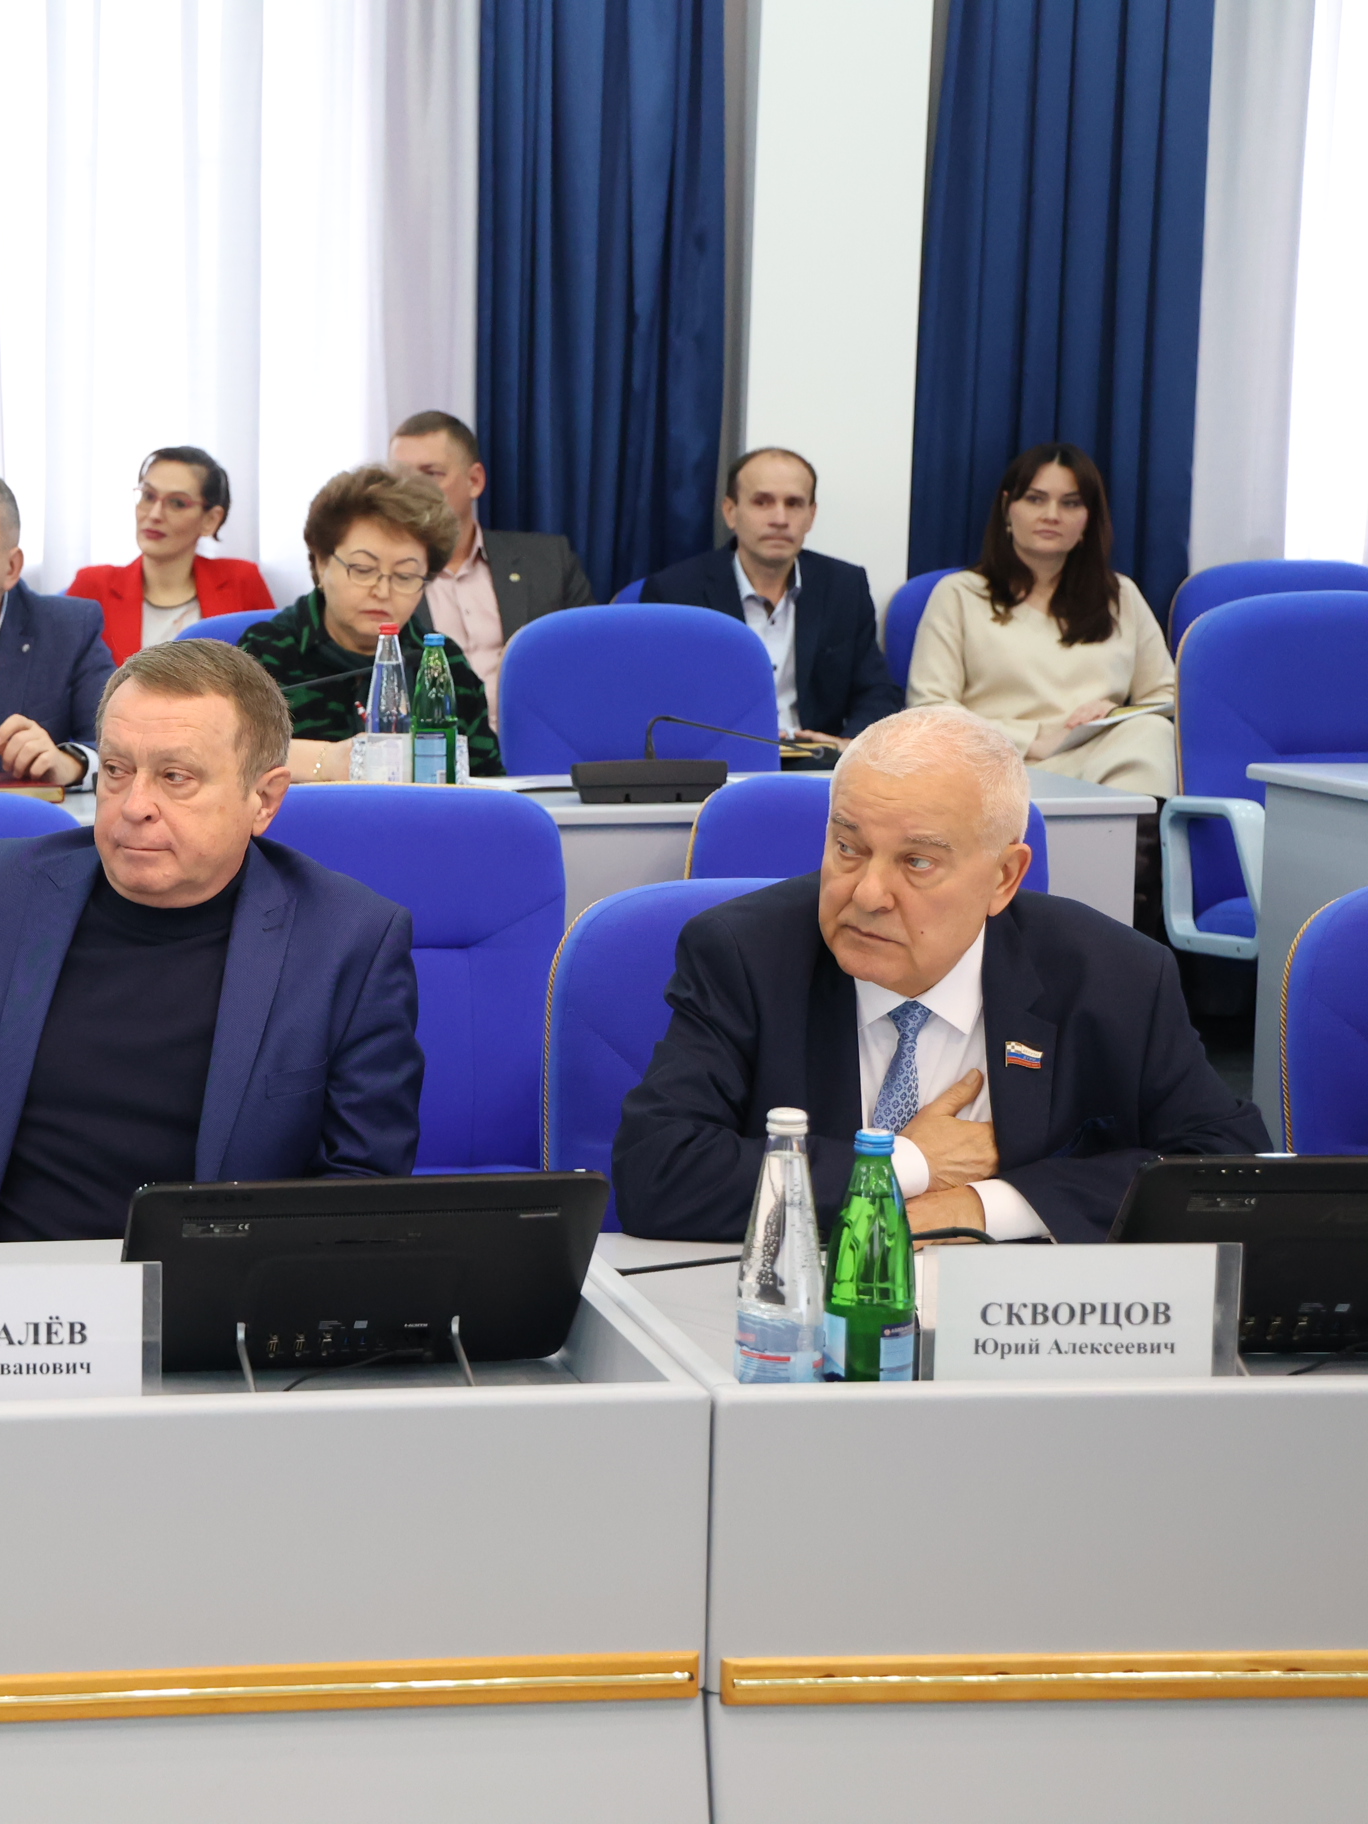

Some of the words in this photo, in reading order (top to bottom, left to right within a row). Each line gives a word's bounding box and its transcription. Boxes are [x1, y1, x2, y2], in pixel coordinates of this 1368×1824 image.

[980, 1301, 1172, 1330] СКВОРЦОВ
[973, 1338, 1040, 1360] Юрий
[1047, 1339, 1176, 1355] Алексеевич
